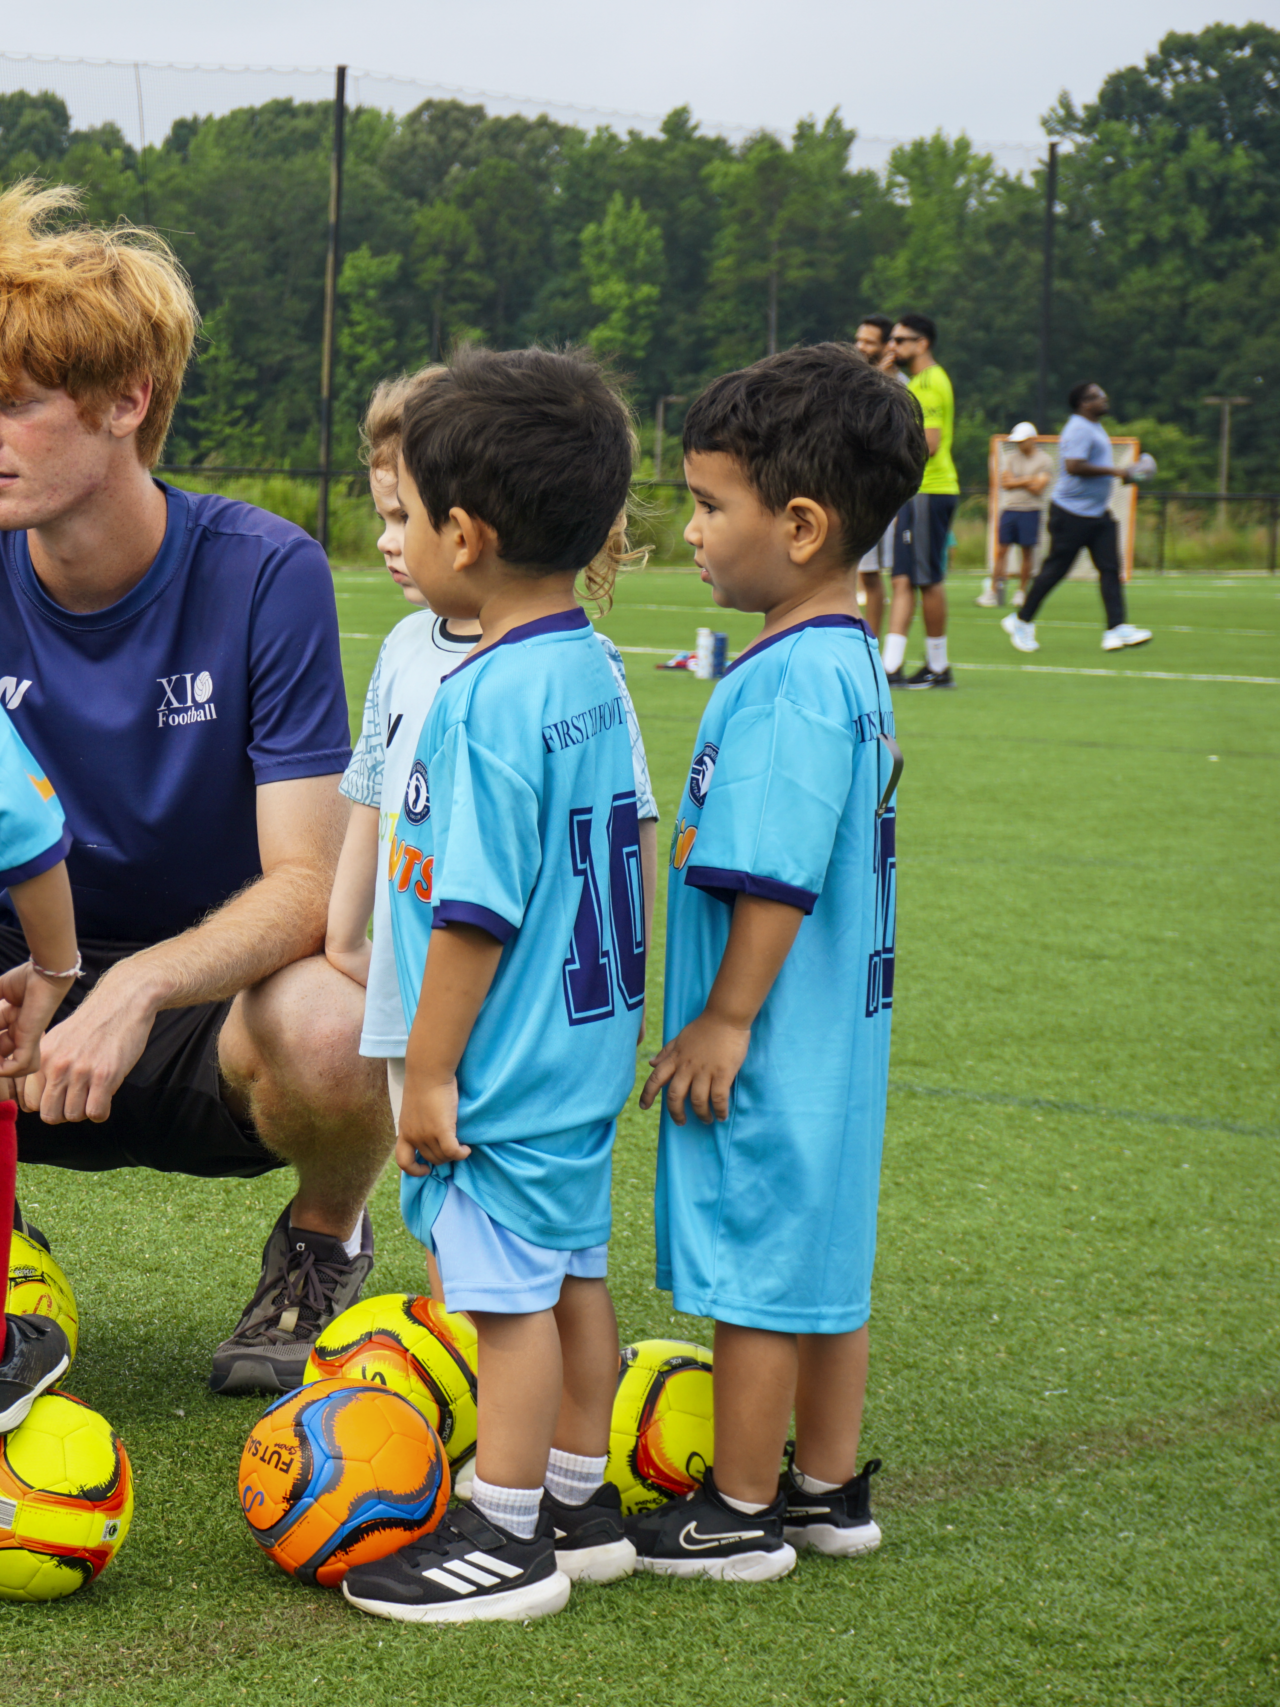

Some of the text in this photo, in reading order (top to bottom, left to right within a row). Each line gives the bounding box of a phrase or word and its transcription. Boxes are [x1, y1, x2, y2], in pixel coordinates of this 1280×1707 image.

[158, 703, 218, 728] Football
[542, 711, 590, 754] FIRST
[563, 790, 646, 1027] 10
